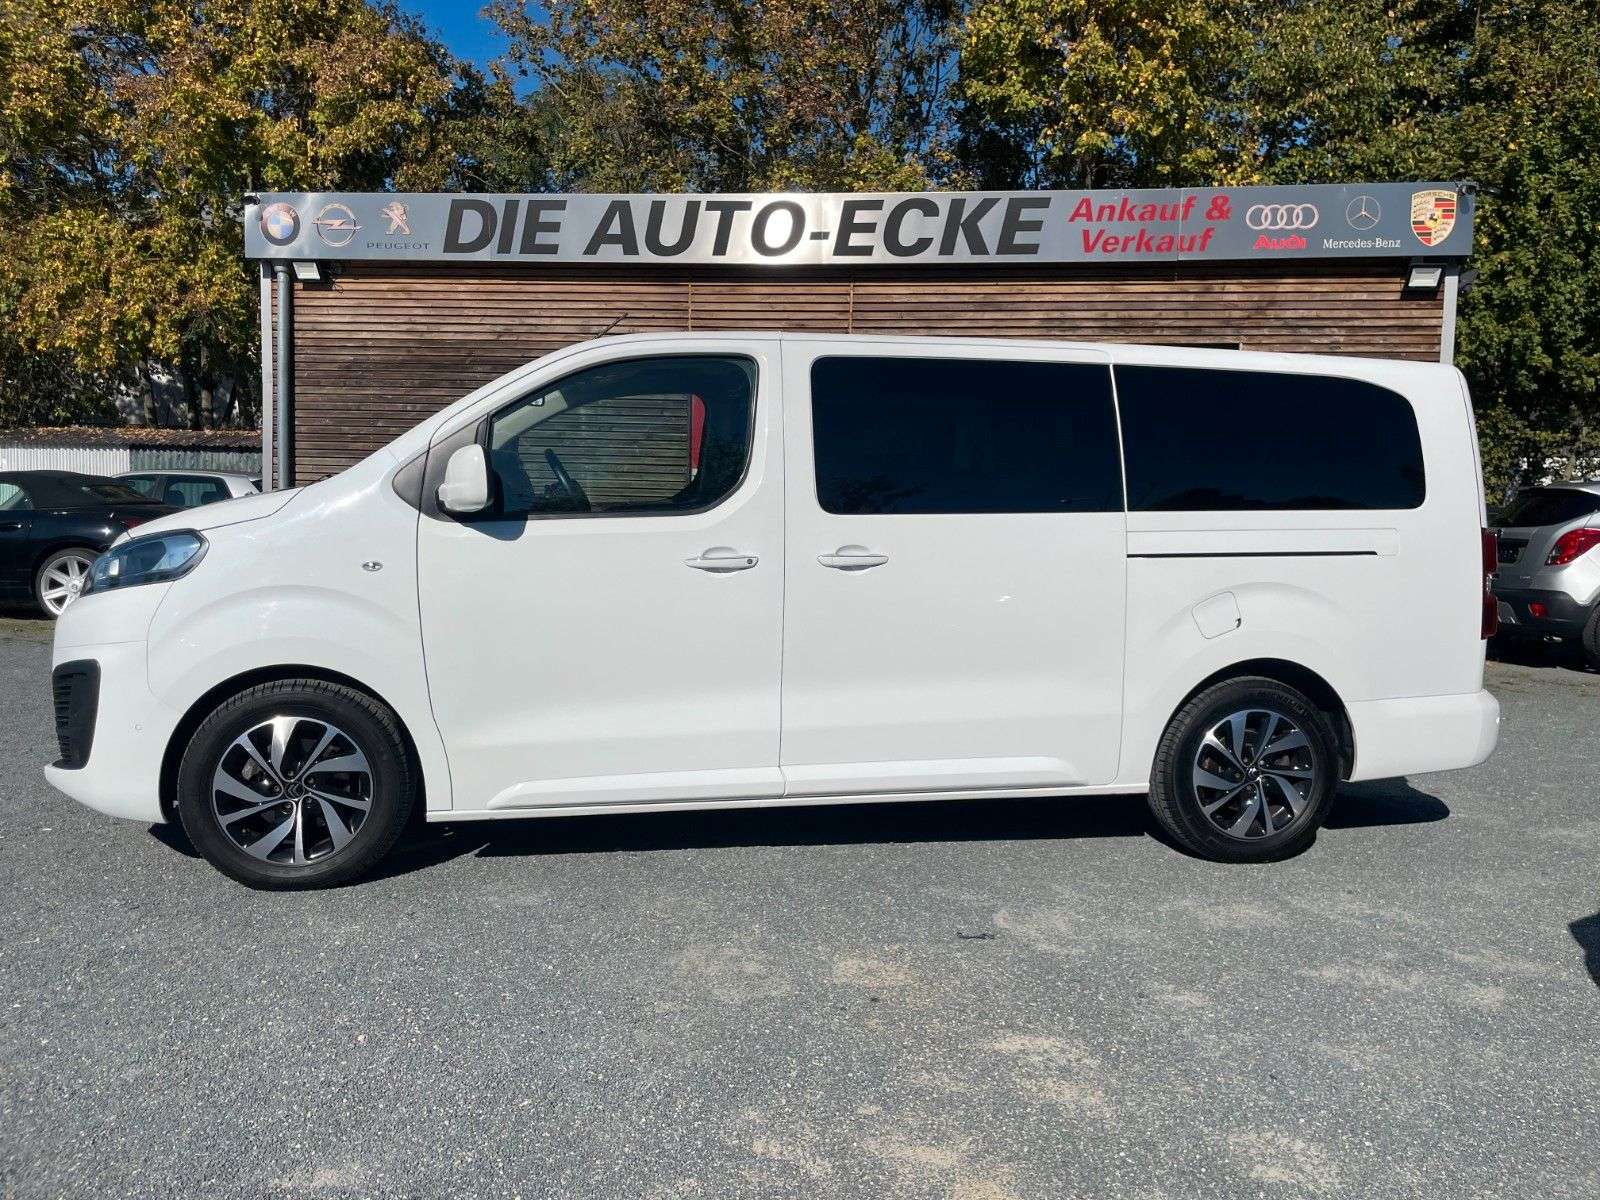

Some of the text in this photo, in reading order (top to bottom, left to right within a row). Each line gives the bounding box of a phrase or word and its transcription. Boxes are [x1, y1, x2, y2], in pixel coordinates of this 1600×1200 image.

[1068, 195, 1232, 222] Ankauf &
[443, 197, 1052, 257] DIE AUTO-ECKE
[366, 242, 430, 250] PEUGEOT
[1081, 227, 1215, 253] Verkauf
[1253, 235, 1308, 250] Audi
[1322, 237, 1401, 249] Mercedes-Benz
